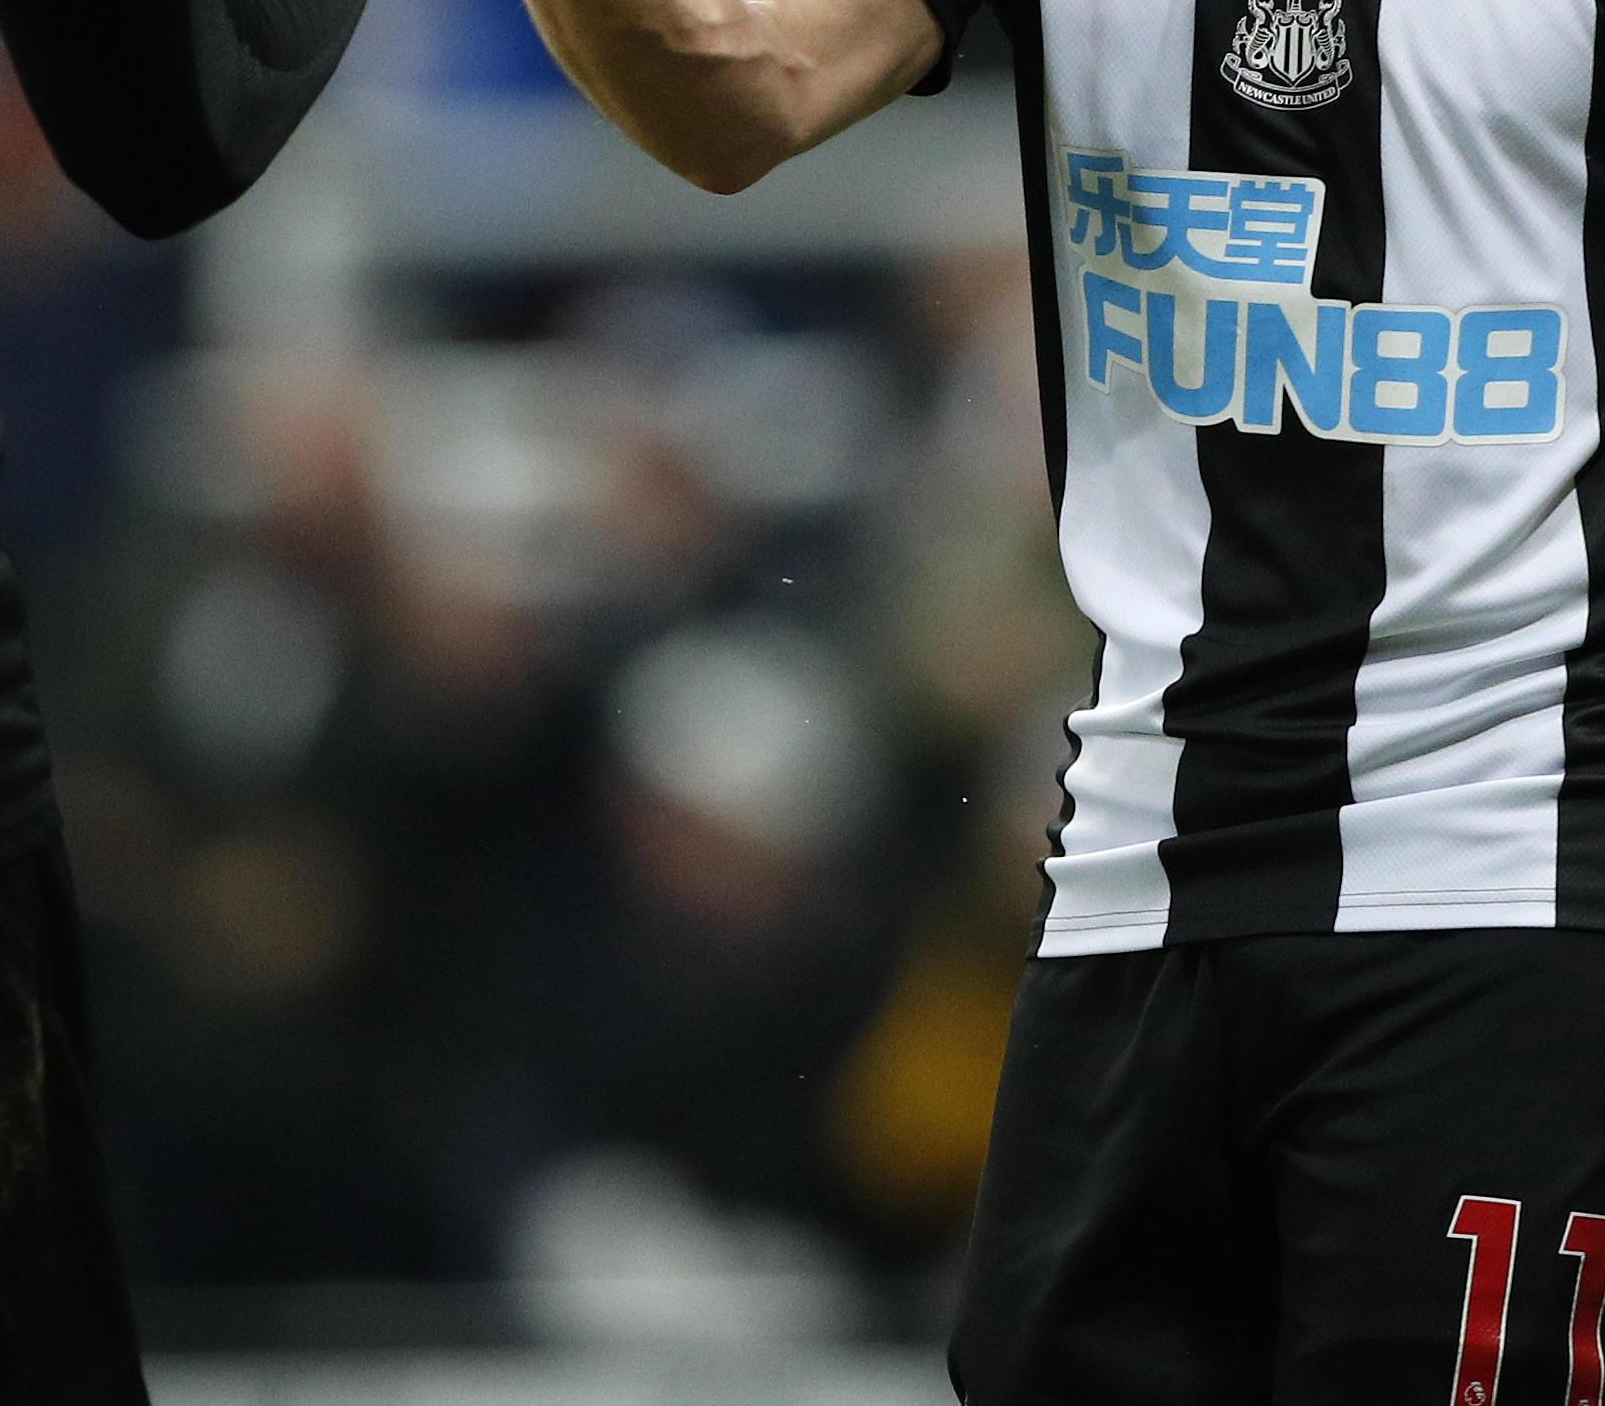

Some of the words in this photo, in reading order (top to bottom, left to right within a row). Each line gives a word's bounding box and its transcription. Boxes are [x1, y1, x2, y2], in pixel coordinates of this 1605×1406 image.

[1237, 81, 1302, 106] NEWCASTLE
[1302, 86, 1337, 105] UNITED
[1067, 151, 1316, 285] 乐天堂
[1083, 270, 1563, 437] FUN88
